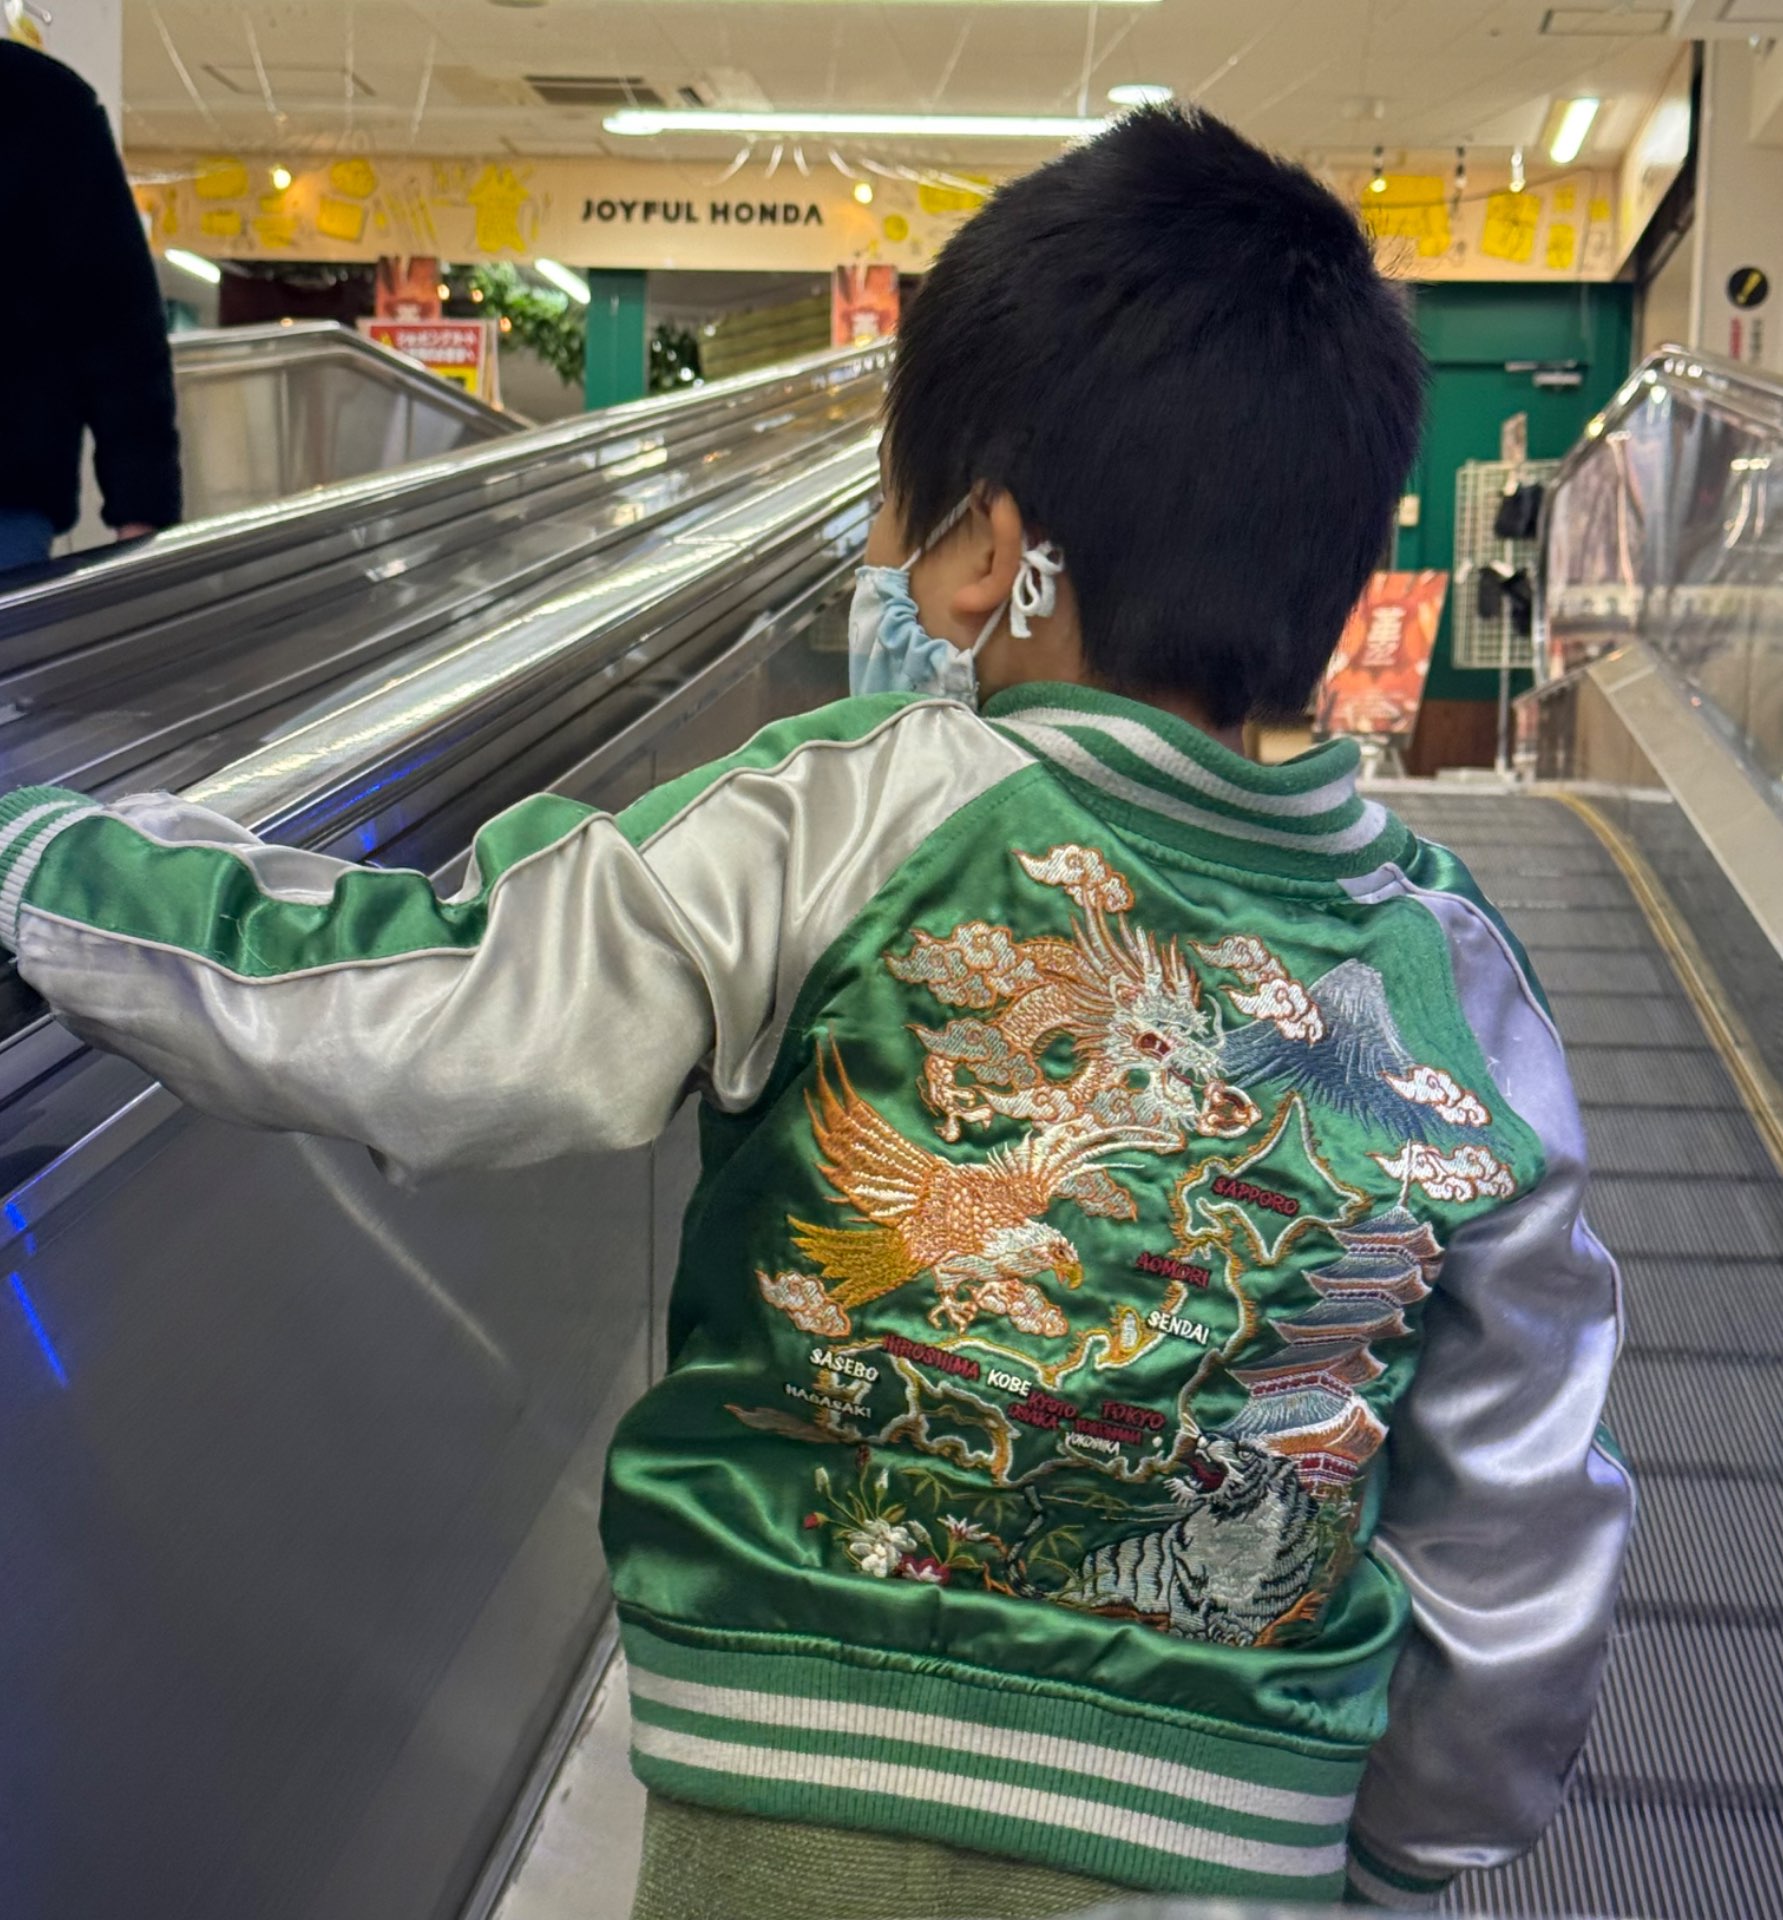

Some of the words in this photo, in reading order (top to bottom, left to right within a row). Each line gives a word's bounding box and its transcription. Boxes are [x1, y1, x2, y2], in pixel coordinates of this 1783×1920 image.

[582, 199, 699, 224] JOYFUL
[711, 202, 823, 226] HONDA
[1212, 1177, 1299, 1215] SAPPORO
[1137, 1252, 1210, 1288] AOMORI
[1147, 1310, 1210, 1345] SENDAI
[809, 1347, 880, 1382] SASEBO
[883, 1335, 980, 1379] HIROSHIMA
[987, 1368, 1032, 1397] KOBE
[1028, 1391, 1077, 1418] KYOTO
[1102, 1402, 1166, 1430] TOKYO
